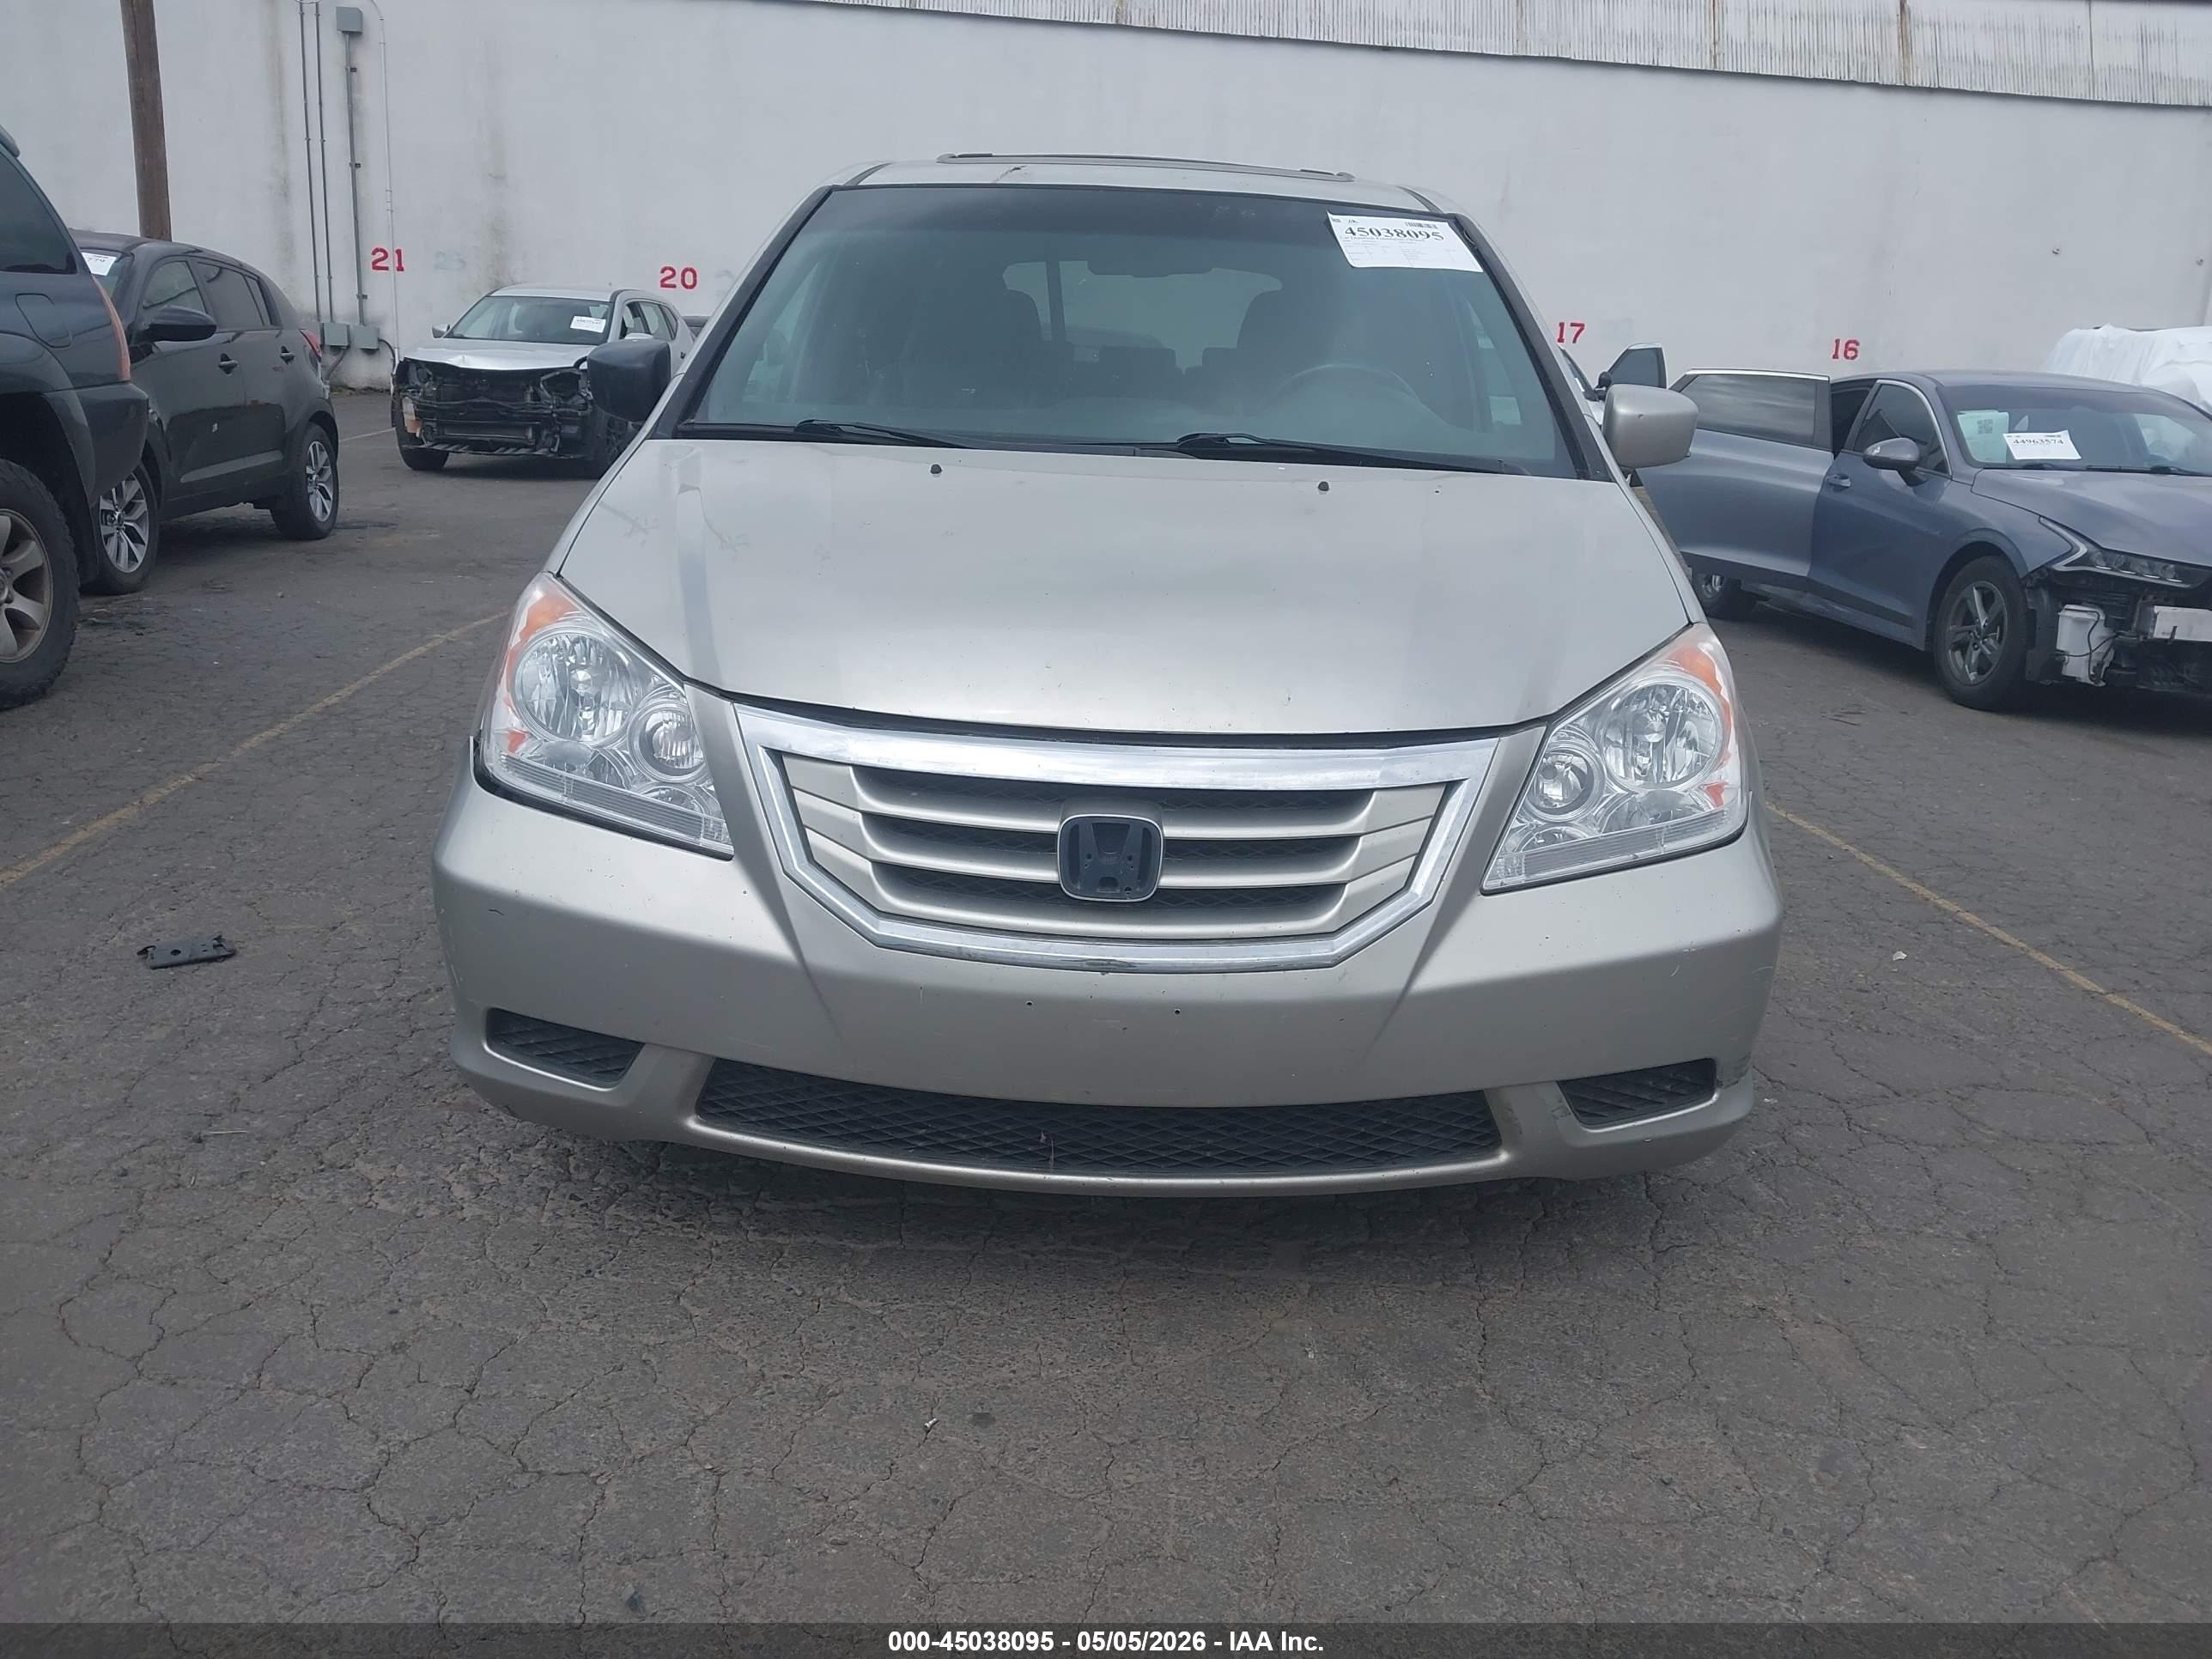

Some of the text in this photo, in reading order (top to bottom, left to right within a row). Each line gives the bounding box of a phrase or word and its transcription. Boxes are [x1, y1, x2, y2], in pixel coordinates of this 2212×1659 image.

[1345, 226, 1445, 241] 45038095
[371, 247, 404, 271] 21
[659, 266, 697, 289] 20
[1557, 322, 1585, 343] 17
[1832, 339, 1860, 360] 16
